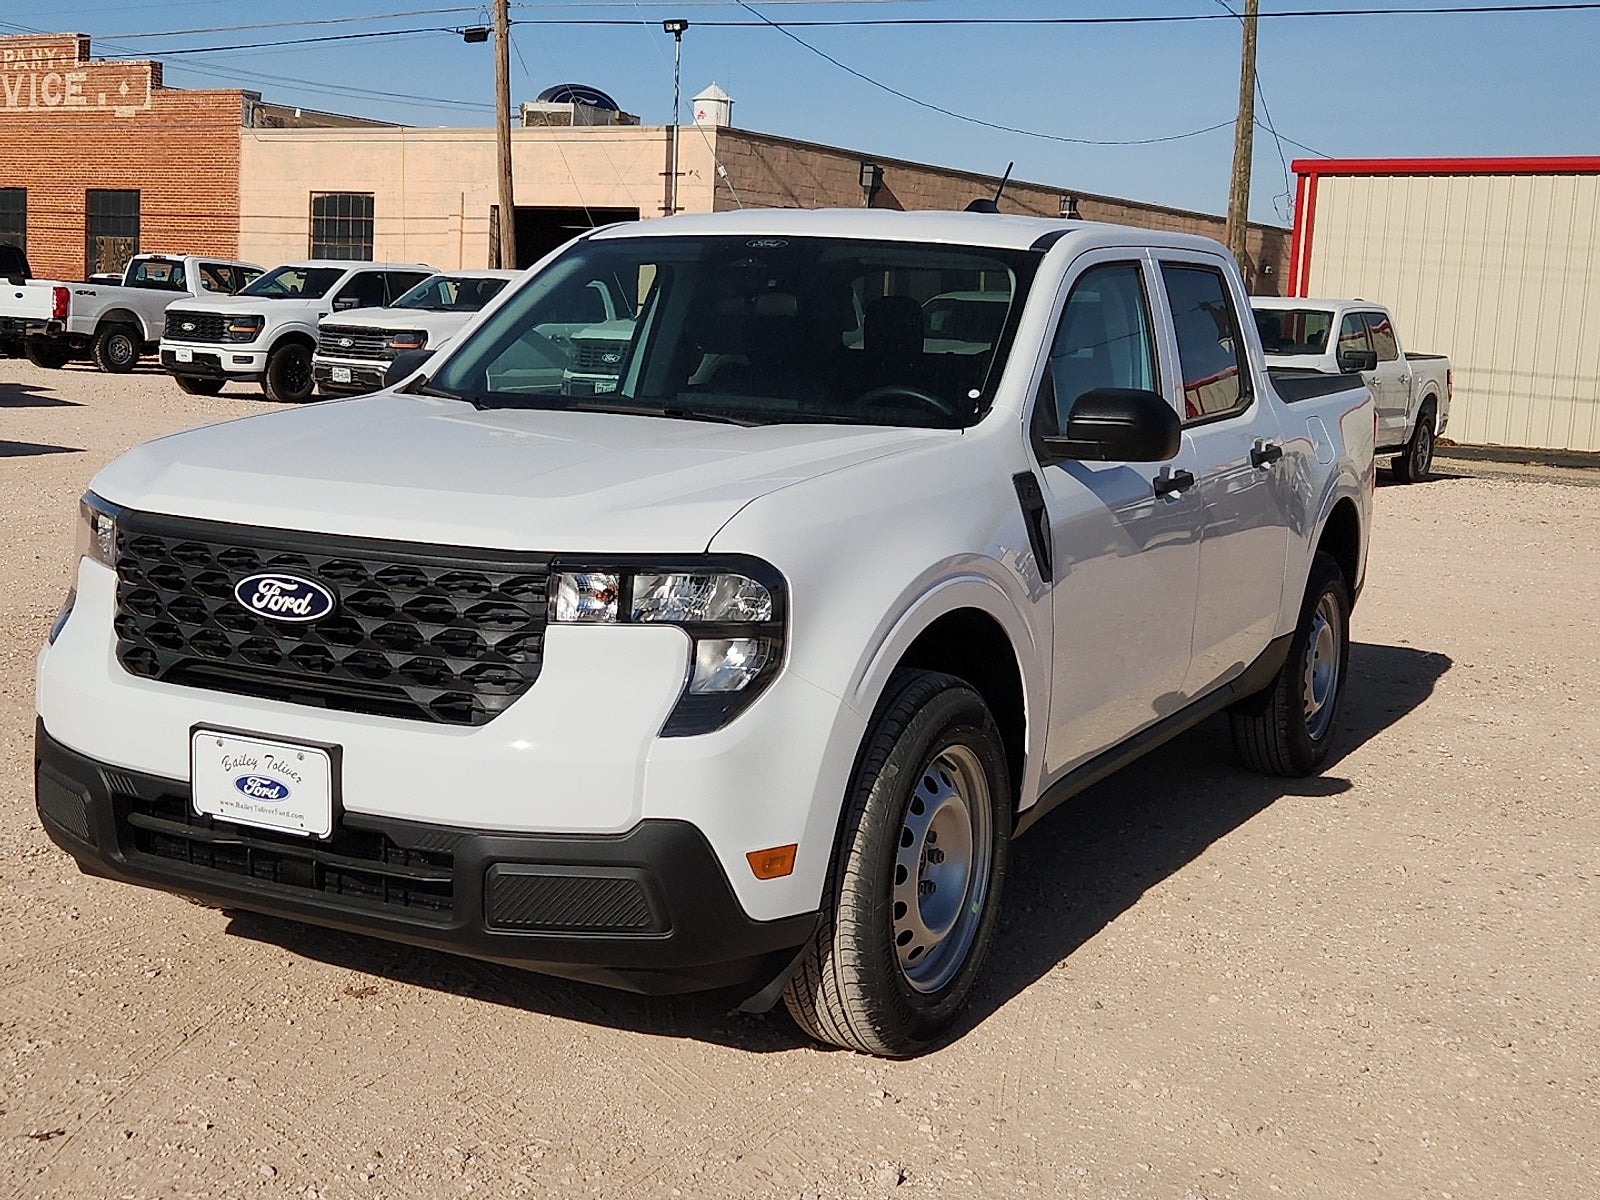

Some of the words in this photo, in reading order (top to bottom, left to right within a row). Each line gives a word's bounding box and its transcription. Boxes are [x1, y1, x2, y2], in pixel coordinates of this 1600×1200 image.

[252, 579, 313, 615] Ford
[221, 754, 258, 772] Bailey
[264, 754, 302, 784] Toliver
[243, 776, 280, 799] Ford
